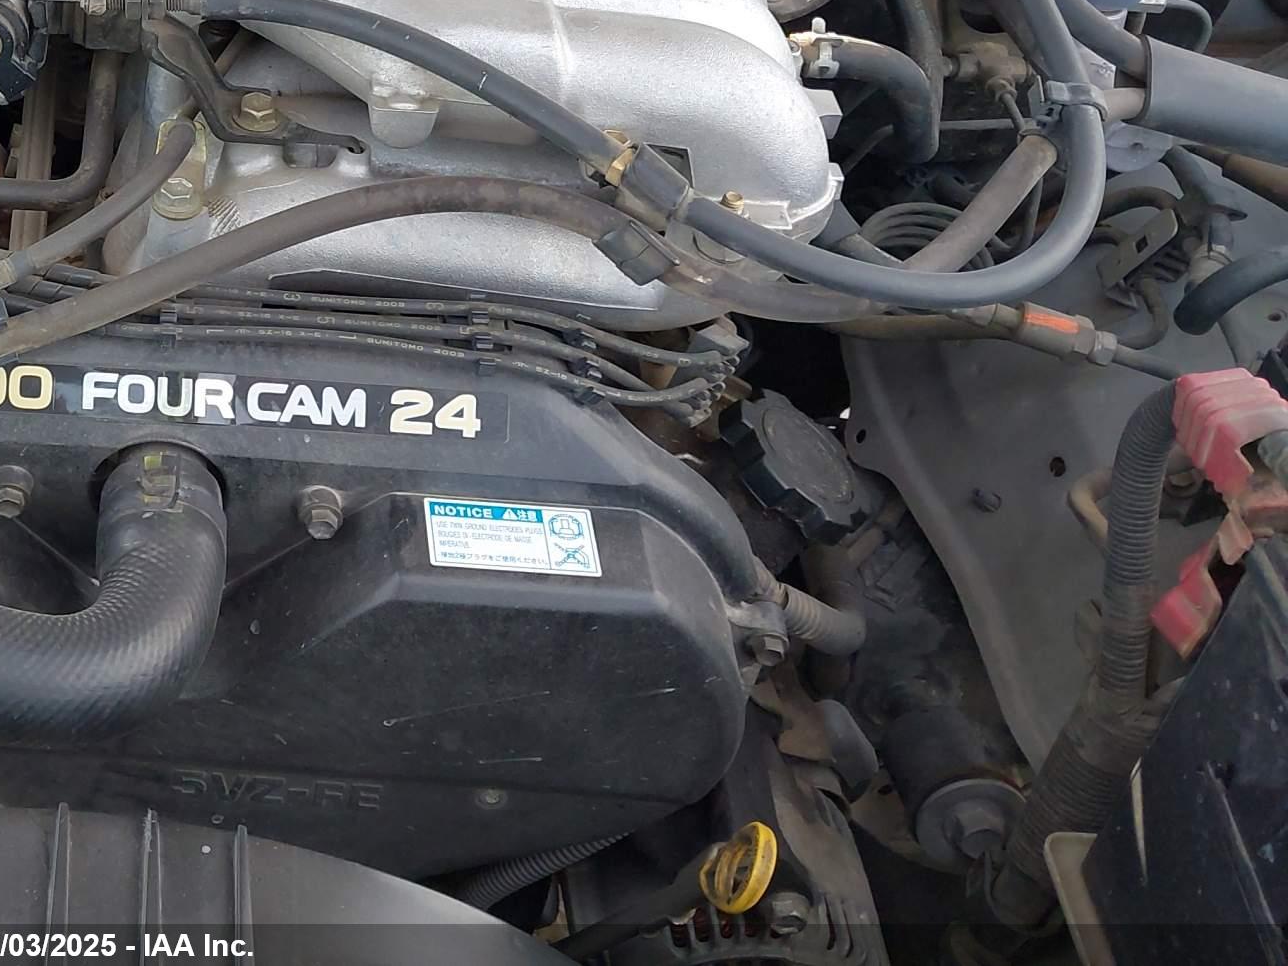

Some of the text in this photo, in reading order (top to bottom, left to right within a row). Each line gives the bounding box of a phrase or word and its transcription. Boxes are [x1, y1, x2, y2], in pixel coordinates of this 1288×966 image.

[311, 296, 367, 306] SUMITOMO
[366, 337, 424, 352] SUMITOMO
[81, 371, 236, 419] FOUR
[246, 382, 367, 428] CAM
[389, 389, 482, 439] 24
[433, 504, 494, 518] NOTICE
